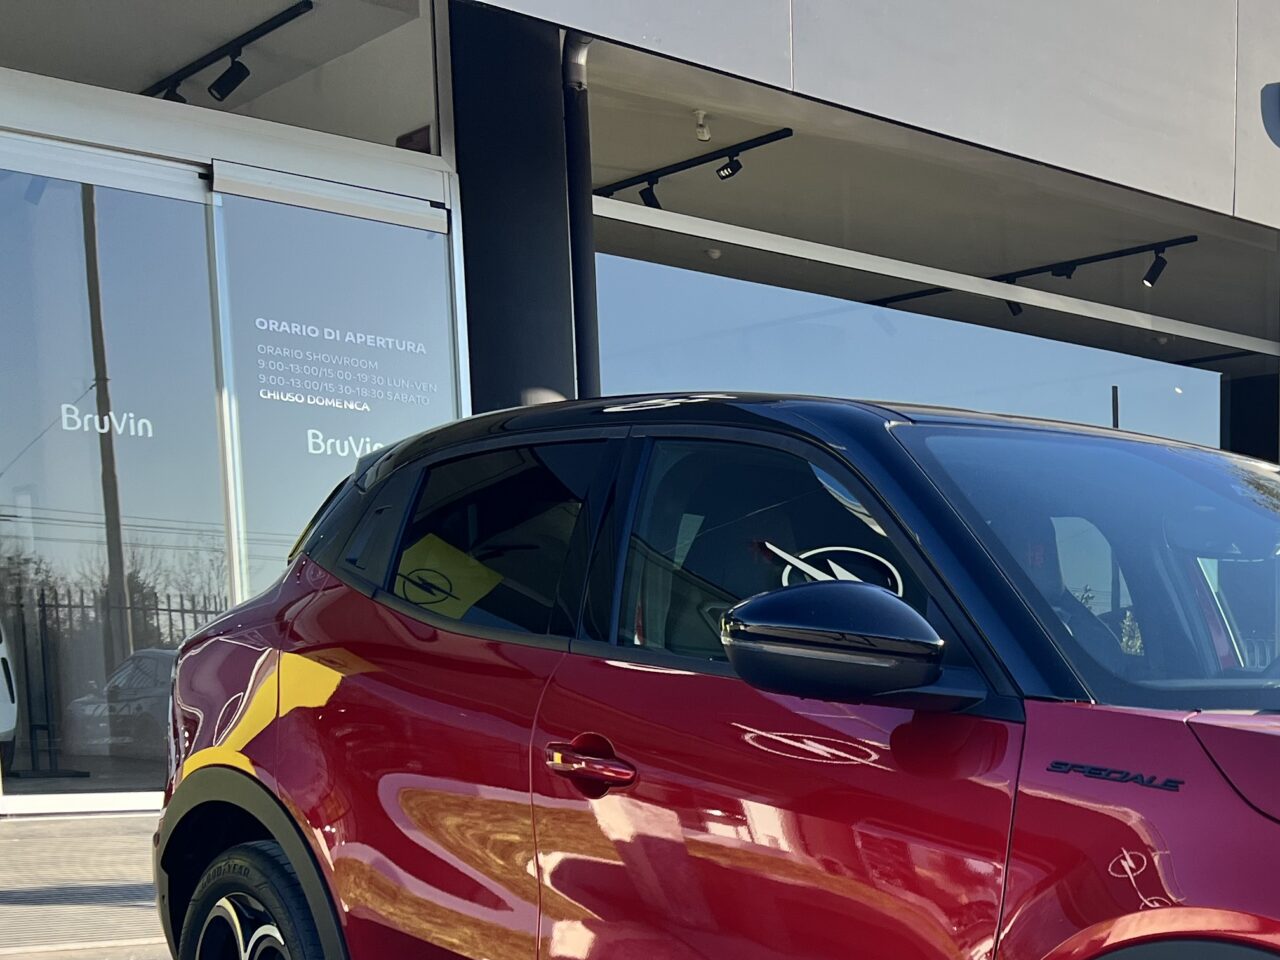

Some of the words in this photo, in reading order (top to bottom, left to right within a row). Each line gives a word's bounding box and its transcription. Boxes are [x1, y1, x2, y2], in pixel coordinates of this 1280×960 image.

[255, 317, 320, 338] ORARIO
[323, 327, 340, 341] DI
[345, 331, 427, 354] APERTURA
[257, 344, 304, 360] ORARIO
[305, 351, 379, 370] SHOWROOM
[386, 376, 438, 393] LUN-VEN
[259, 388, 305, 403] CHIUSO
[307, 394, 371, 412] DOMENICA
[386, 391, 430, 406] SABATO
[60, 403, 153, 438] BruVin
